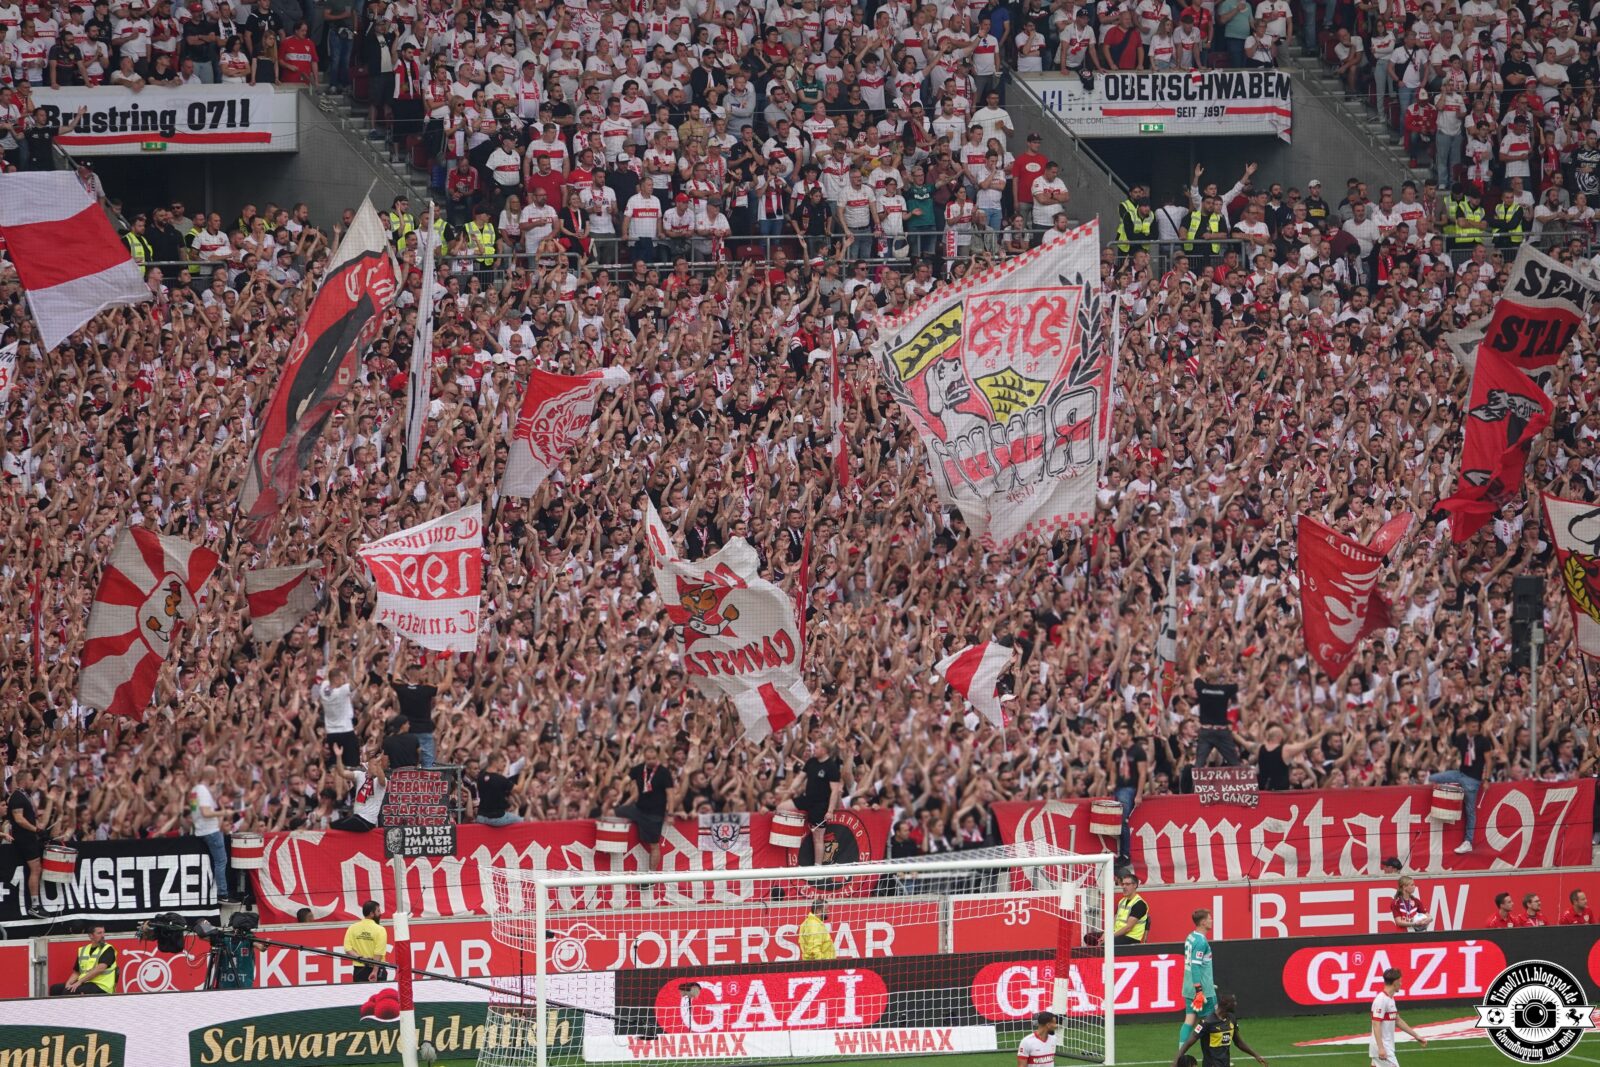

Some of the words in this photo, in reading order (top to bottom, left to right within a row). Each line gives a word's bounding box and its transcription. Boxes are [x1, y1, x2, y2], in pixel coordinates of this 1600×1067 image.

[1104, 72, 1291, 101] OBERSCHWABEN
[40, 103, 176, 138] Brustring
[187, 98, 250, 130] 0711
[1176, 106, 1196, 118] SEIT
[1204, 105, 1225, 118] 1997
[1192, 770, 1231, 781] ULTRA
[1236, 769, 1256, 780] IST
[1194, 784, 1216, 794] DER
[1221, 782, 1259, 793] KAMPF
[389, 793, 441, 805] KEHRT
[1222, 792, 1259, 806] GANZE
[404, 827, 420, 836] DU
[426, 826, 452, 835] BIST
[404, 836, 452, 846] IMMER
[1014, 796, 1460, 890] Cnnstatt
[1485, 786, 1578, 869] 97
[404, 846, 422, 855] BEI
[426, 845, 453, 854] UNS!
[40, 854, 218, 912] UMSETZEN
[1003, 900, 1031, 926] 35
[606, 922, 895, 970] JOKERSAR
[201, 1011, 572, 1065] Schwarzwldmilch
[627, 1033, 748, 1059] WINAMAX
[834, 1028, 955, 1054] WINAMAX
